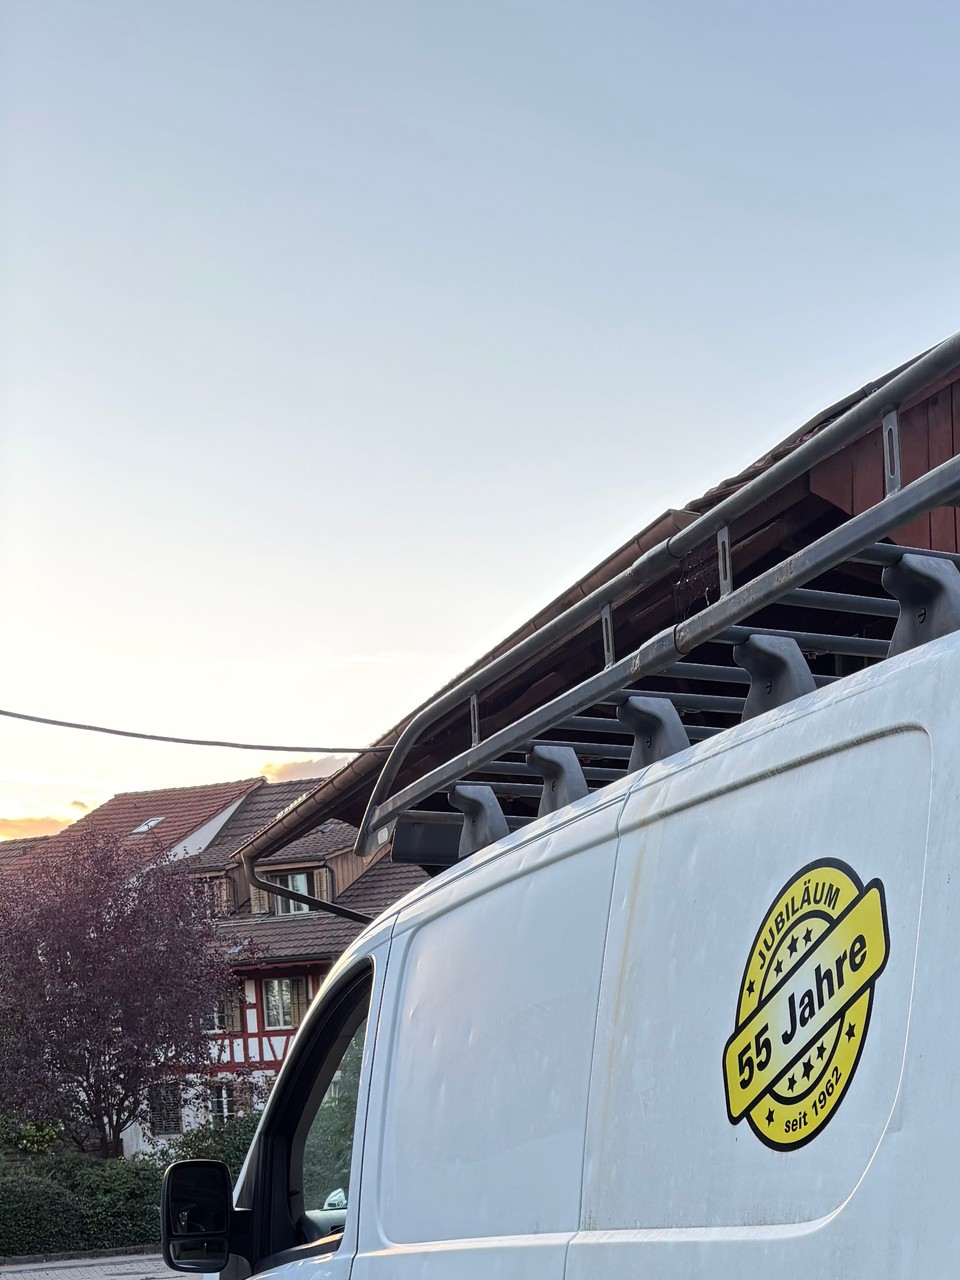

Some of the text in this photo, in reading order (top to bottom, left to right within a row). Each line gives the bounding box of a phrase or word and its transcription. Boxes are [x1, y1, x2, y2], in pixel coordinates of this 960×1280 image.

[757, 879, 841, 970] JUBILÄUM
[737, 934, 867, 1090] 55 Jahre
[784, 1065, 842, 1134] seit 1962
